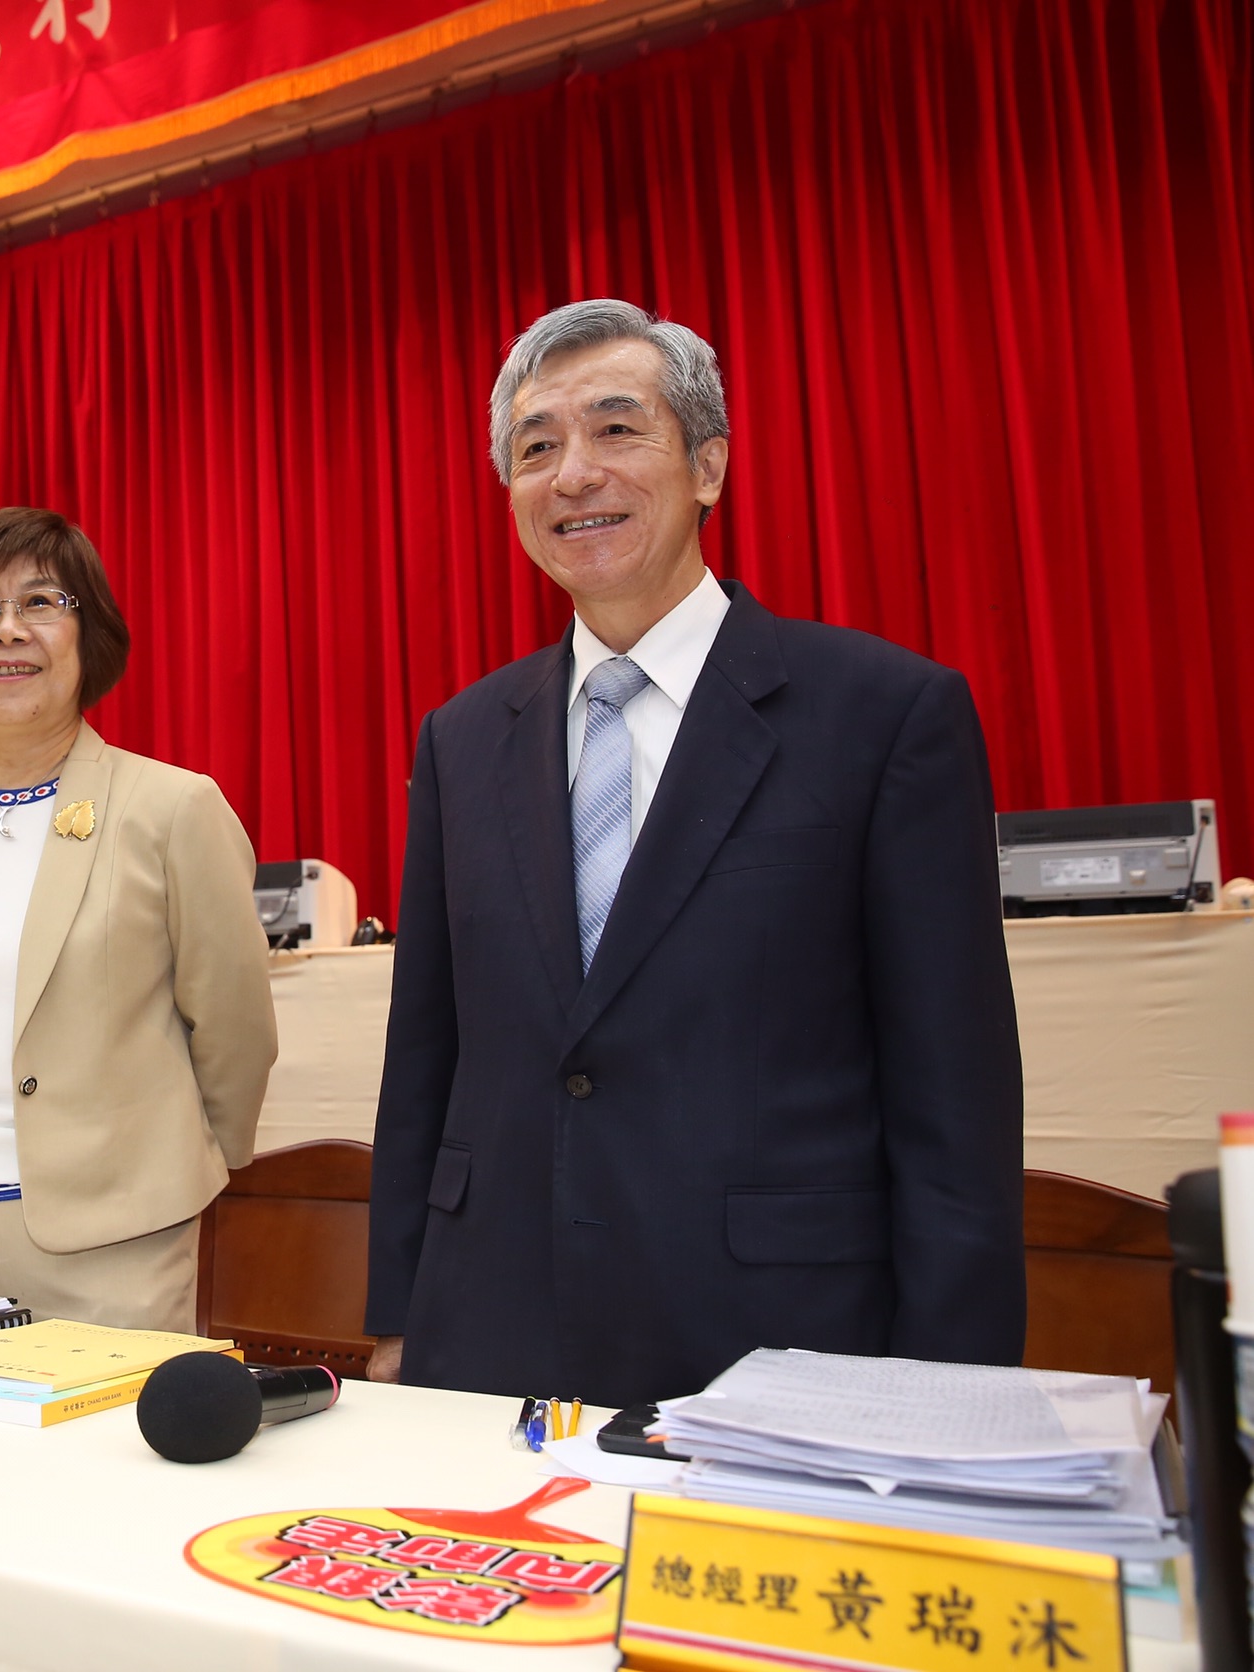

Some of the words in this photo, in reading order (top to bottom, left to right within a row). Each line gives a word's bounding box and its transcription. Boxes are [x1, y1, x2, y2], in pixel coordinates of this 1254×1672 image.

[277, 1515, 626, 1594] 向前走
[651, 1554, 1088, 1669] 總經理黃瑞沐
